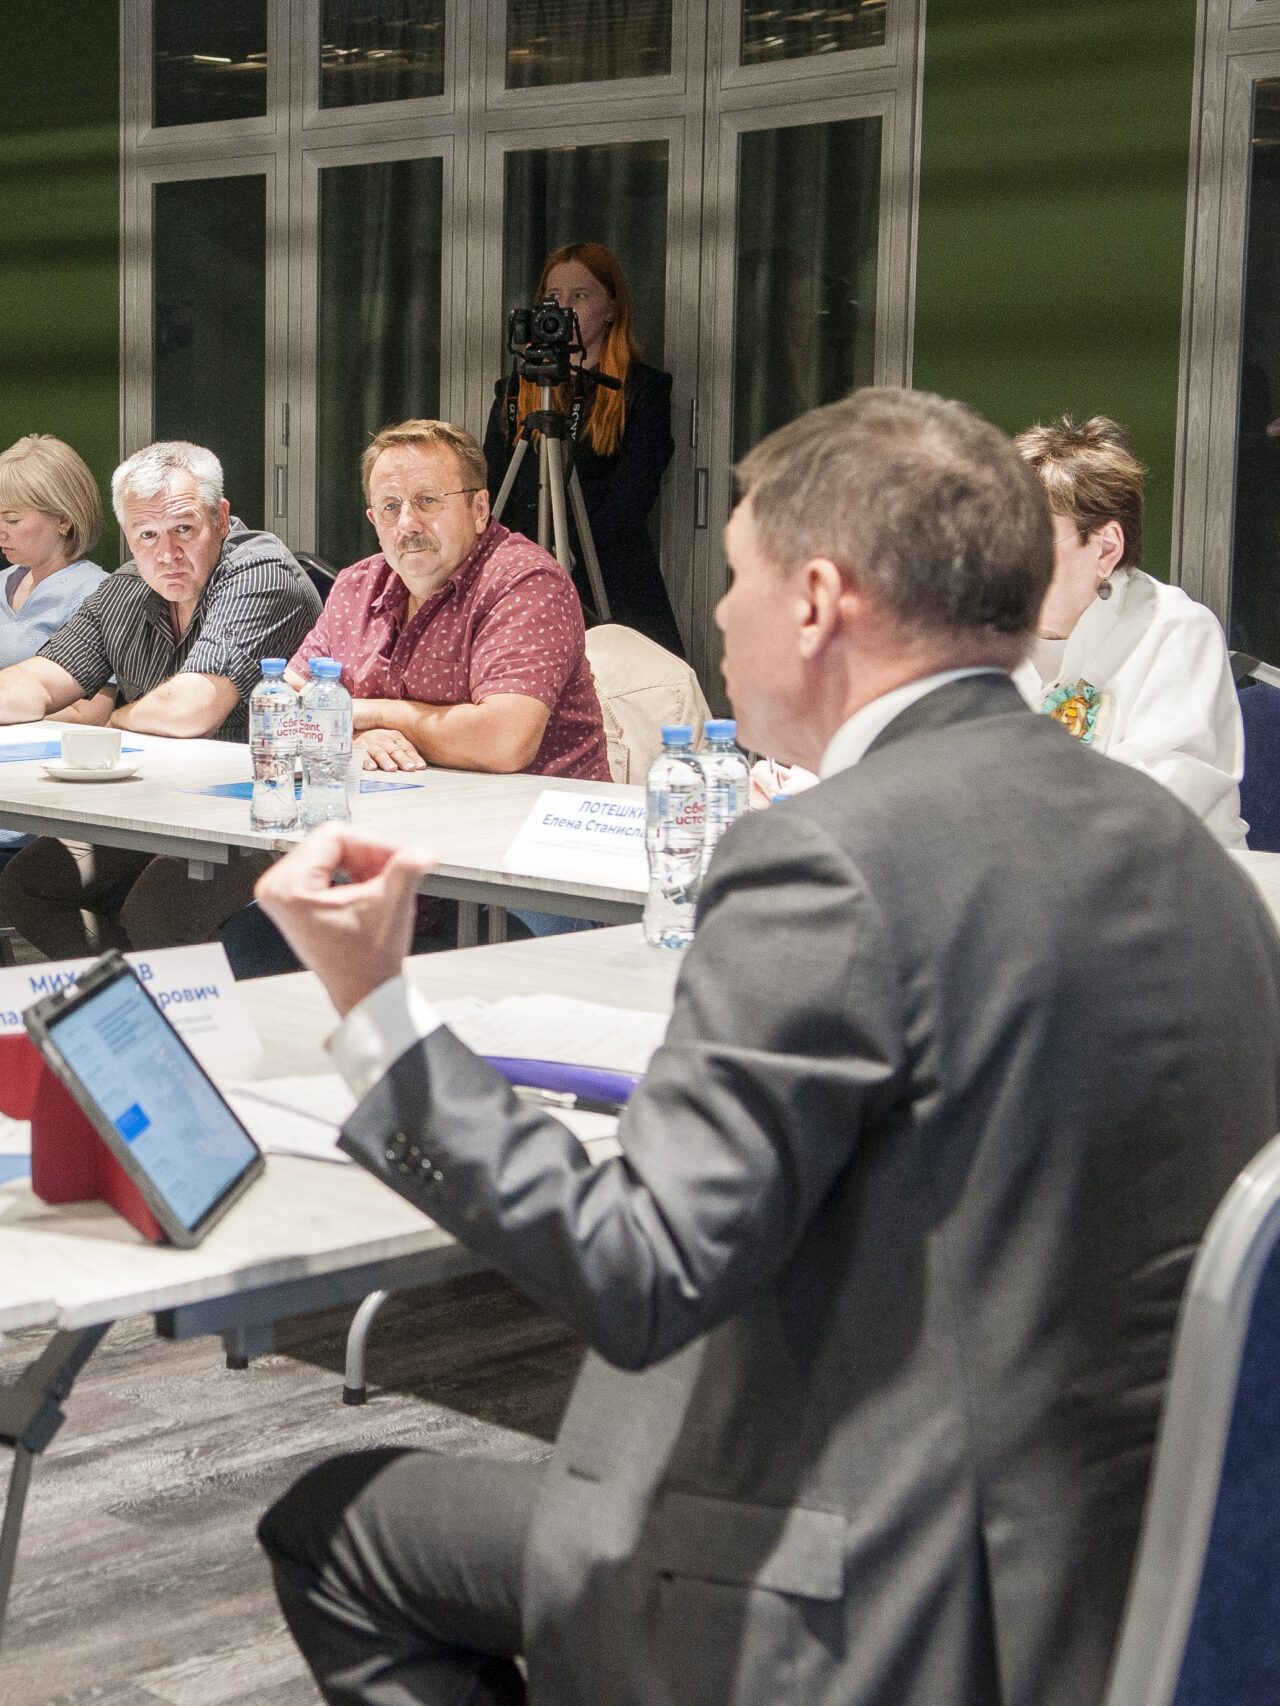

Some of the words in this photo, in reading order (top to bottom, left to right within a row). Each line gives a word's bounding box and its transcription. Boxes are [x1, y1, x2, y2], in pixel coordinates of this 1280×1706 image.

[579, 800, 647, 820] ПОТЕШКИ
[542, 813, 582, 830] Елена
[585, 819, 647, 839] Станисла
